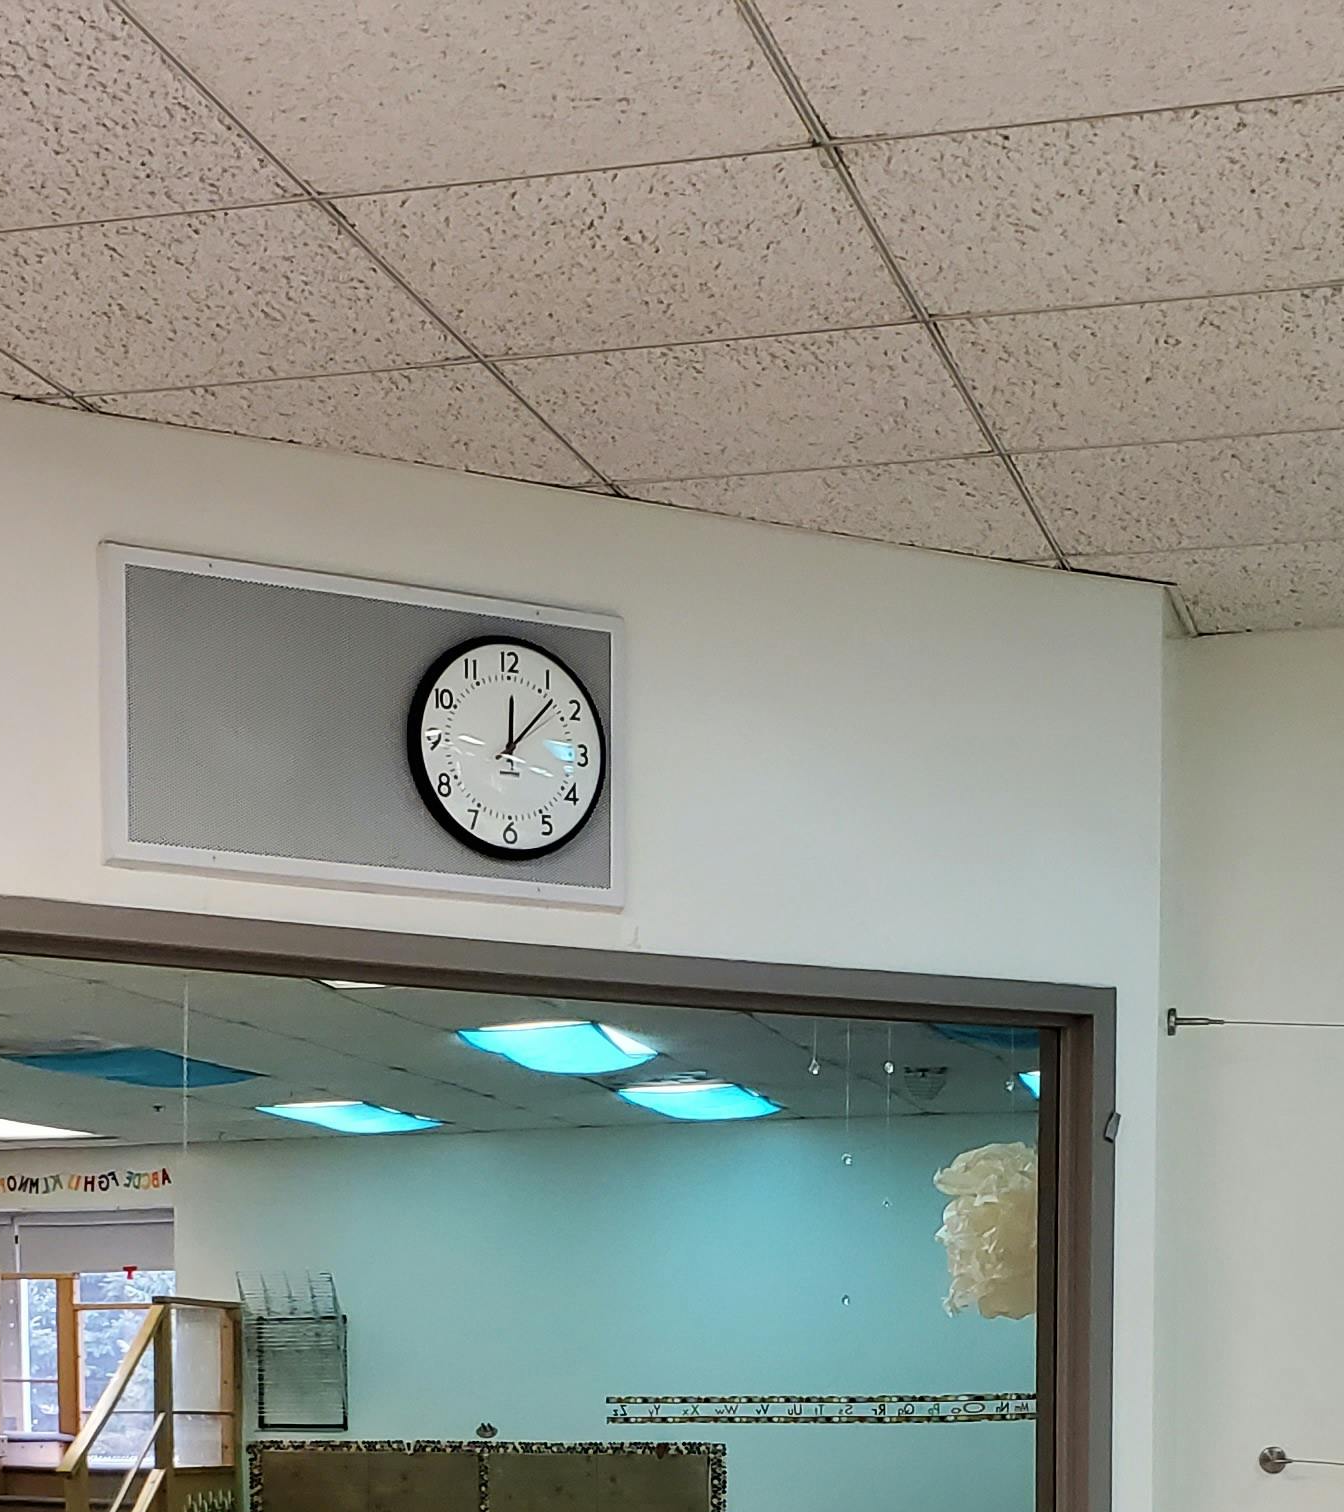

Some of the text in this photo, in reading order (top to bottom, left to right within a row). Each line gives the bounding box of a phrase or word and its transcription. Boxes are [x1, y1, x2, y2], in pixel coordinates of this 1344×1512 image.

[464, 657, 477, 681] 11
[500, 651, 519, 674] 12
[434, 688, 454, 709] 10
[569, 699, 581, 721] 2
[426, 727, 442, 750] 9
[577, 744, 589, 767] 3
[437, 772, 452, 797] 8
[564, 782, 580, 806] 4
[467, 808, 479, 830] 7
[541, 814, 553, 836] 5
[502, 822, 518, 844] 6
